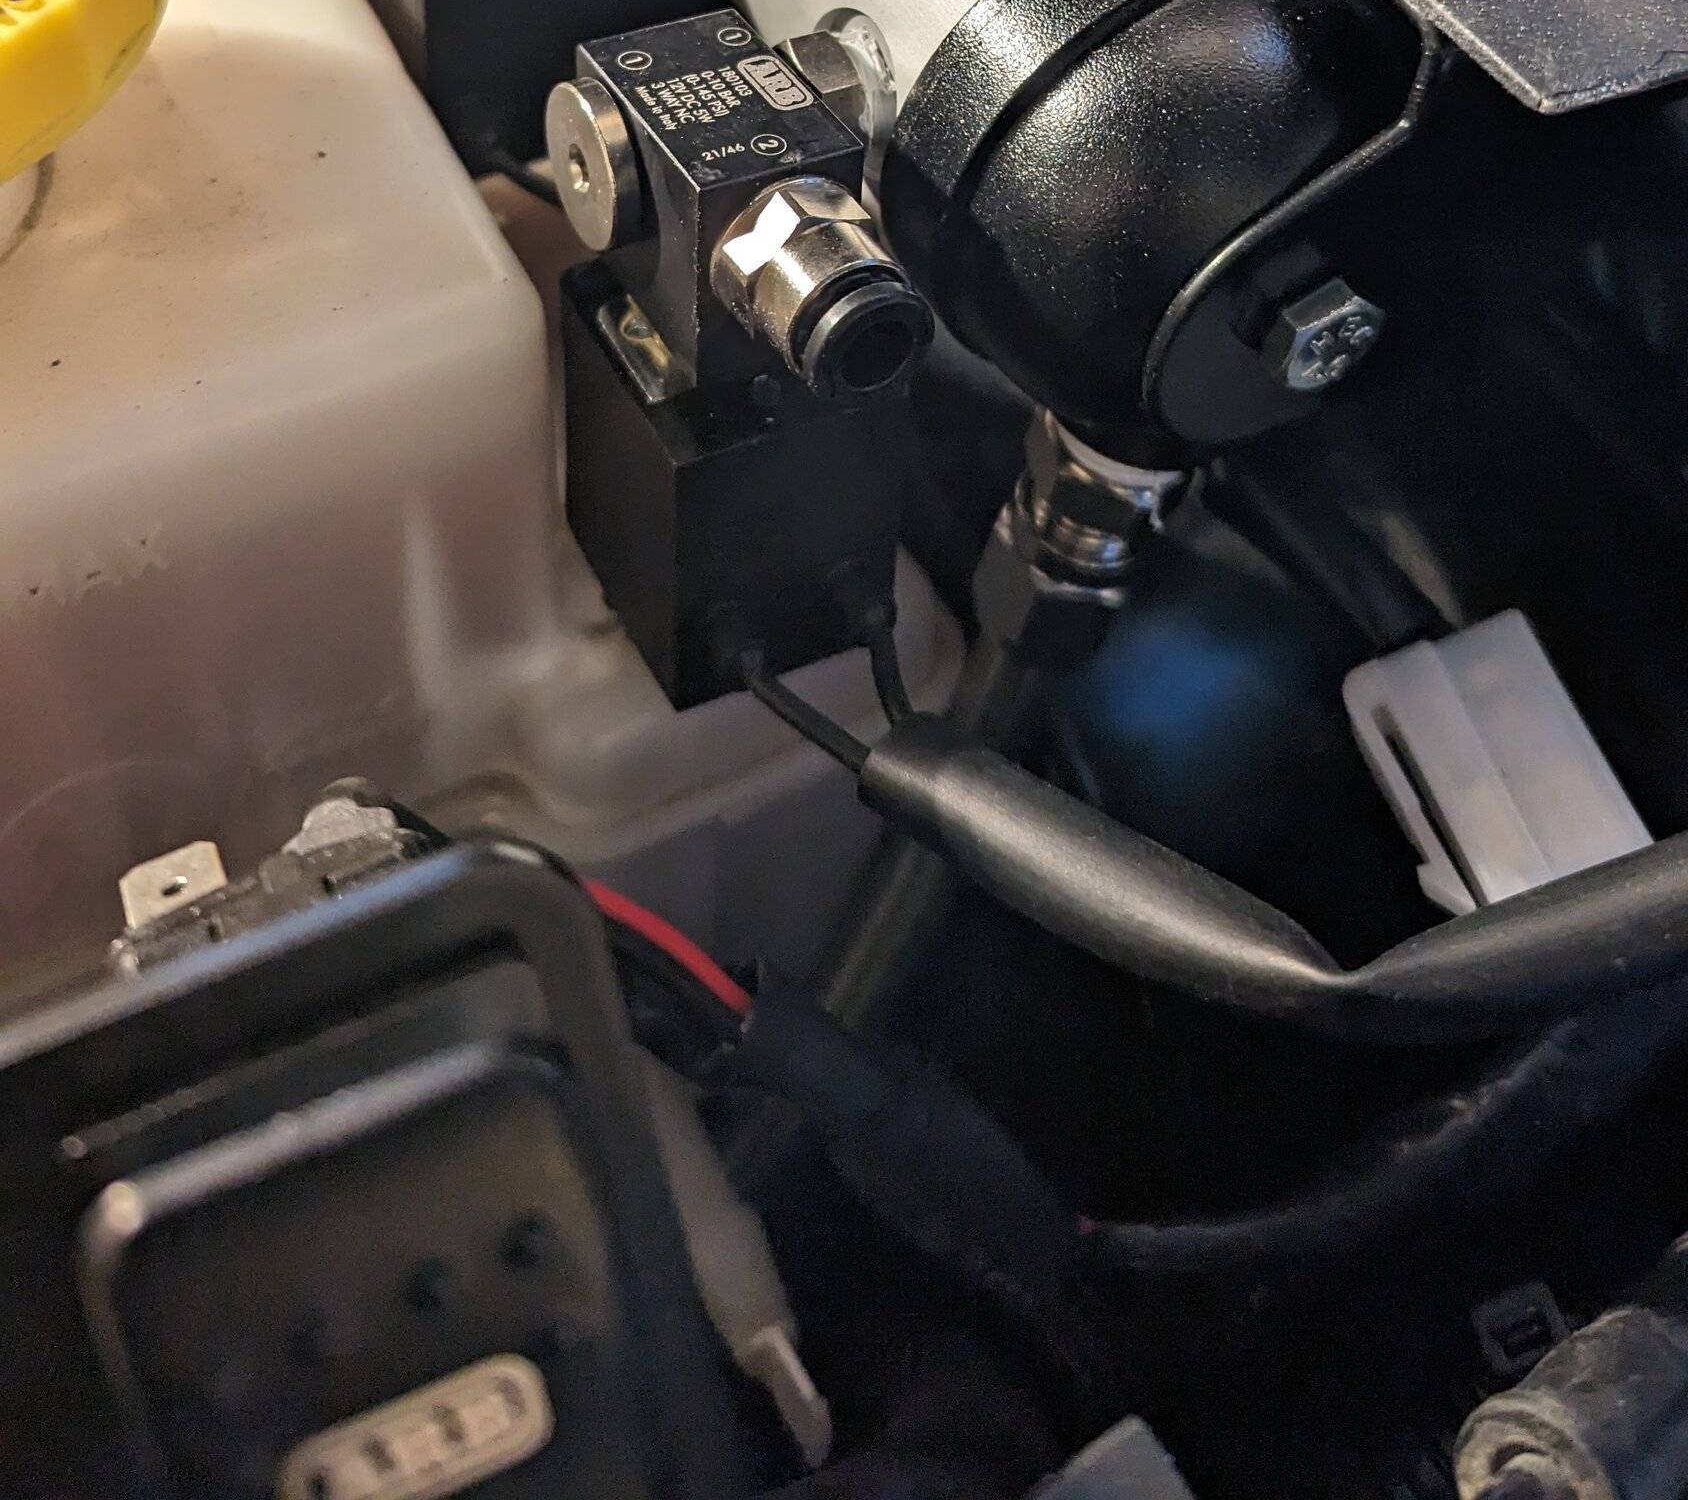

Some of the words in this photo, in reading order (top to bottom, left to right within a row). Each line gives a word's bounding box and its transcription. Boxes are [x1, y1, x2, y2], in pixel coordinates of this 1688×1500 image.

[667, 77, 690, 94] 12V
[681, 93, 702, 109] DC
[693, 108, 716, 123] 5W
[681, 73, 717, 101] (0-145
[708, 100, 730, 117] PSI)
[701, 70, 726, 91] 0-10
[718, 89, 741, 108] BAR
[718, 65, 753, 97] 180103
[743, 59, 808, 107] ARB
[635, 85, 657, 107] Made
[659, 113, 678, 131] Italy
[658, 88, 683, 108] WAY
[674, 107, 695, 124] NC
[701, 142, 746, 162] 21/46
